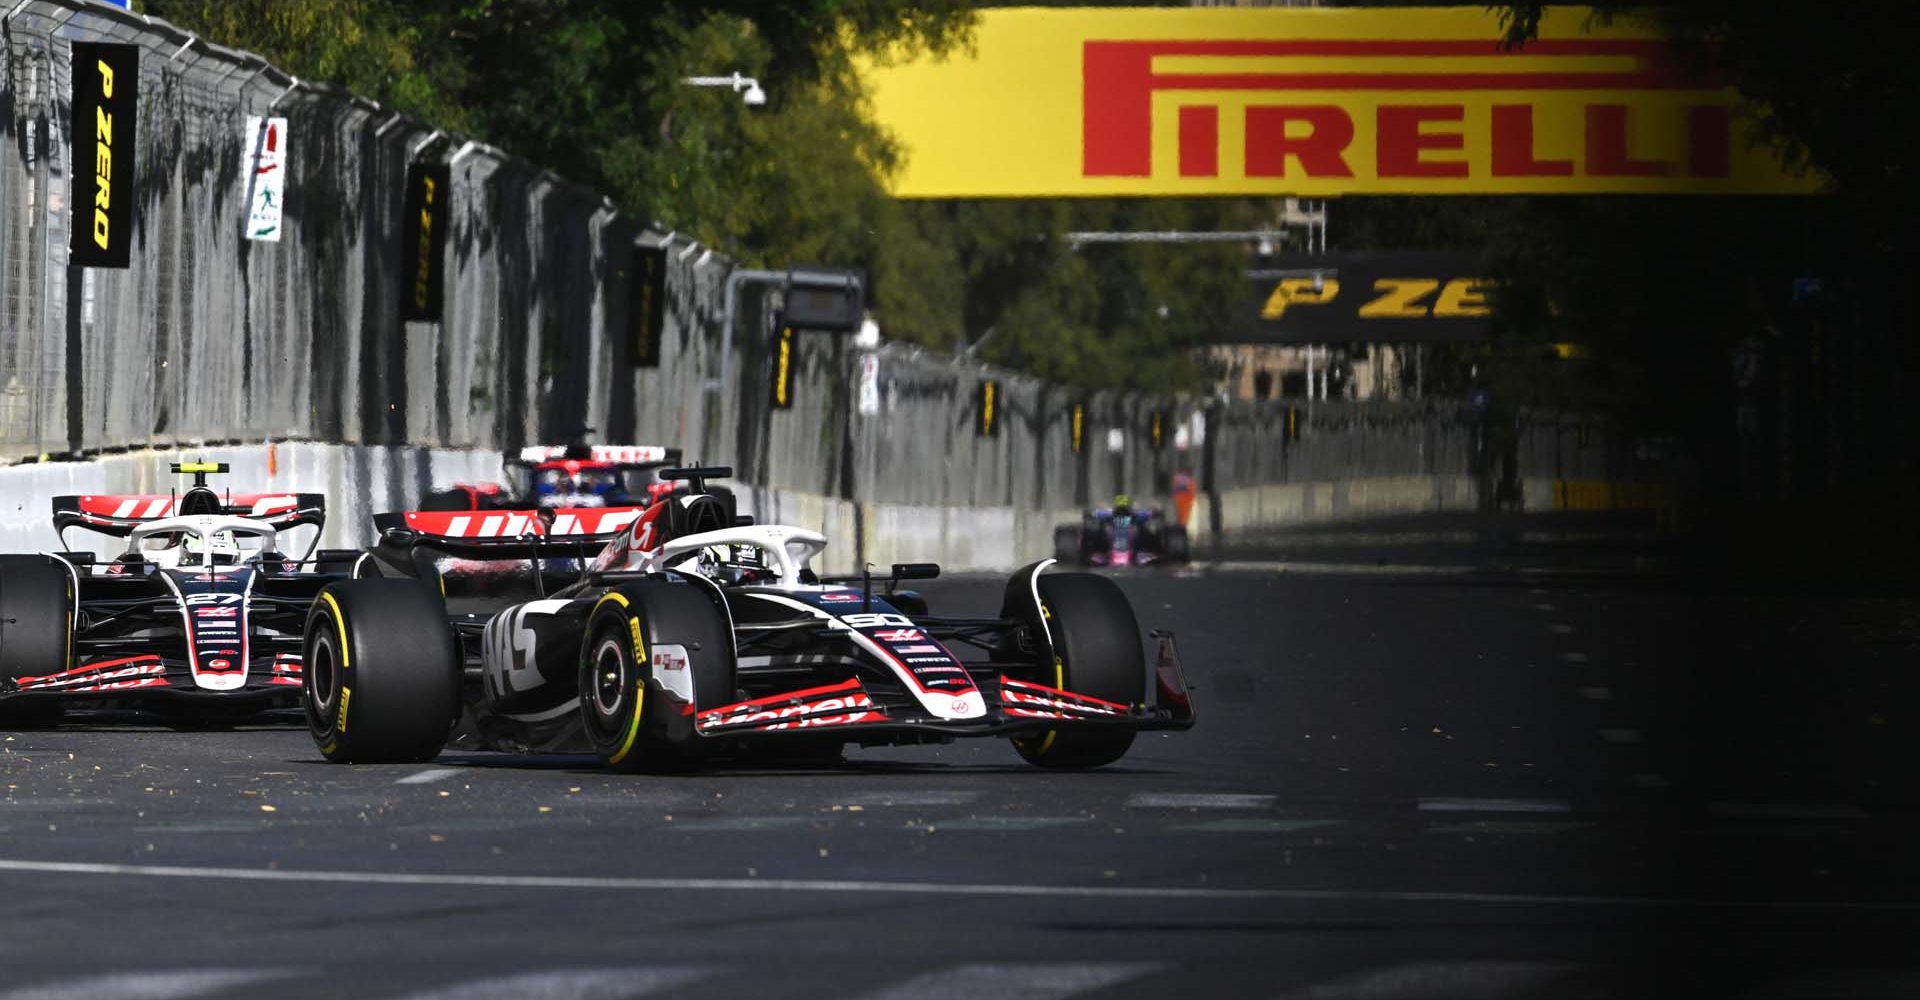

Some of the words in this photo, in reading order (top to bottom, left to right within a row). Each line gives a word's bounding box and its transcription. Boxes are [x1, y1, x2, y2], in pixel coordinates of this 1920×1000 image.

[98, 59, 113, 98] P
[1083, 39, 1730, 178] PIRELLI
[94, 105, 112, 250] ZERO
[1261, 278, 1340, 320] P
[1358, 278, 1495, 318] ZE
[186, 593, 243, 606] 27
[840, 613, 915, 628] 50
